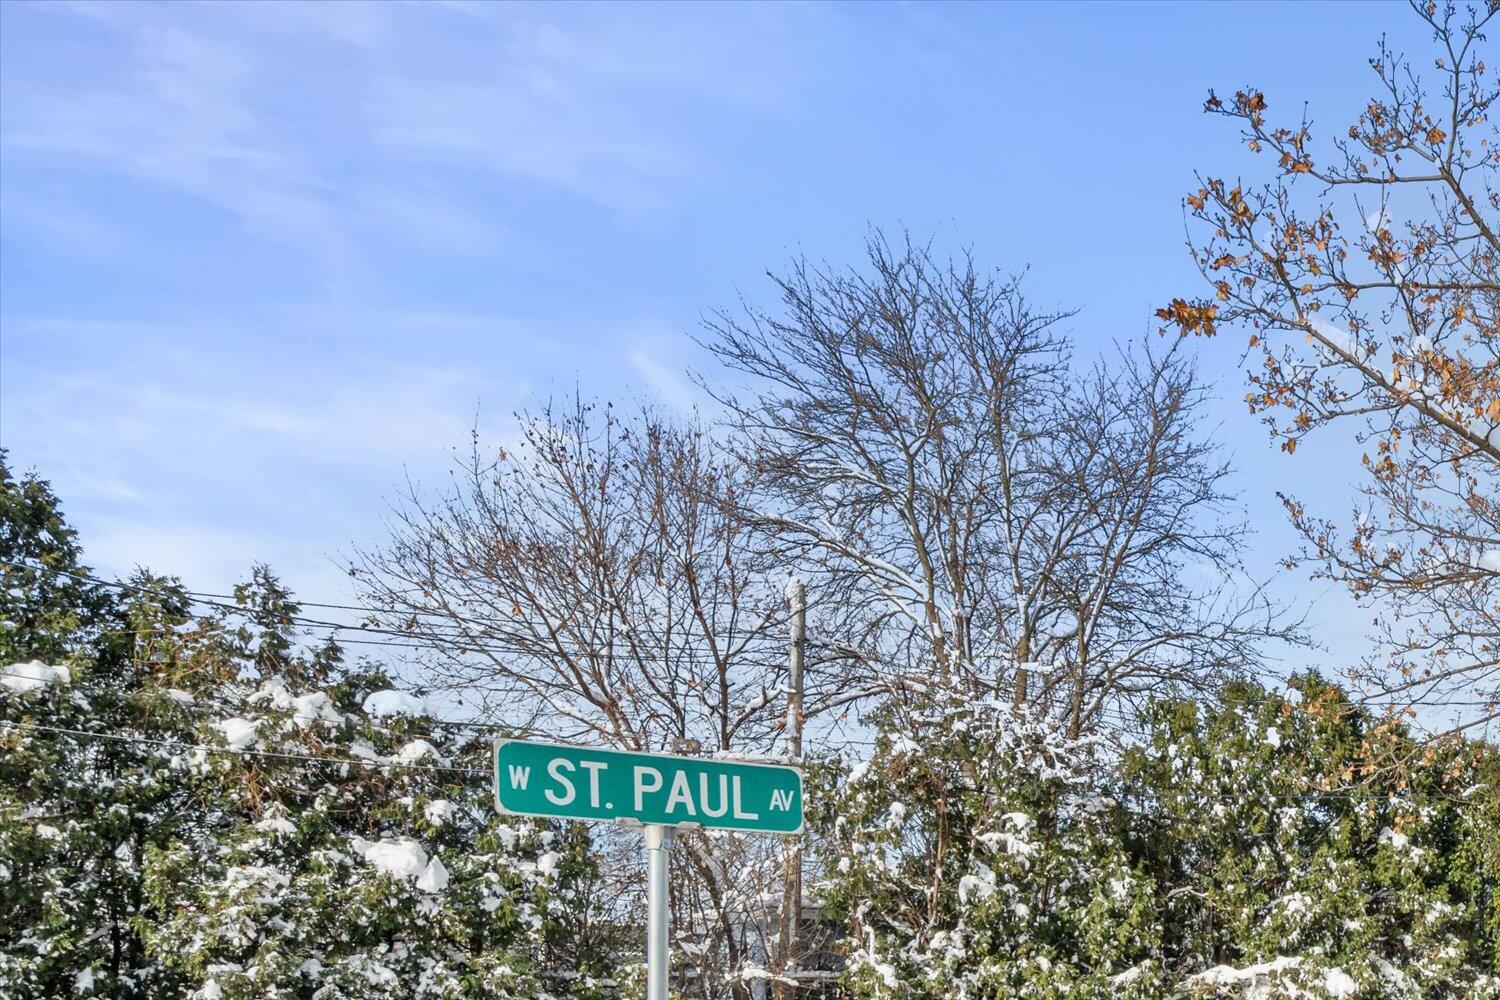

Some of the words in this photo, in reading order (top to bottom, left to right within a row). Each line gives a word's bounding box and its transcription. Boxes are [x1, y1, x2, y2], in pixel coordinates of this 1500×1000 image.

[508, 764, 530, 790] W
[544, 757, 614, 810] ST.
[634, 765, 759, 820] PAUL
[768, 789, 795, 812] AV
